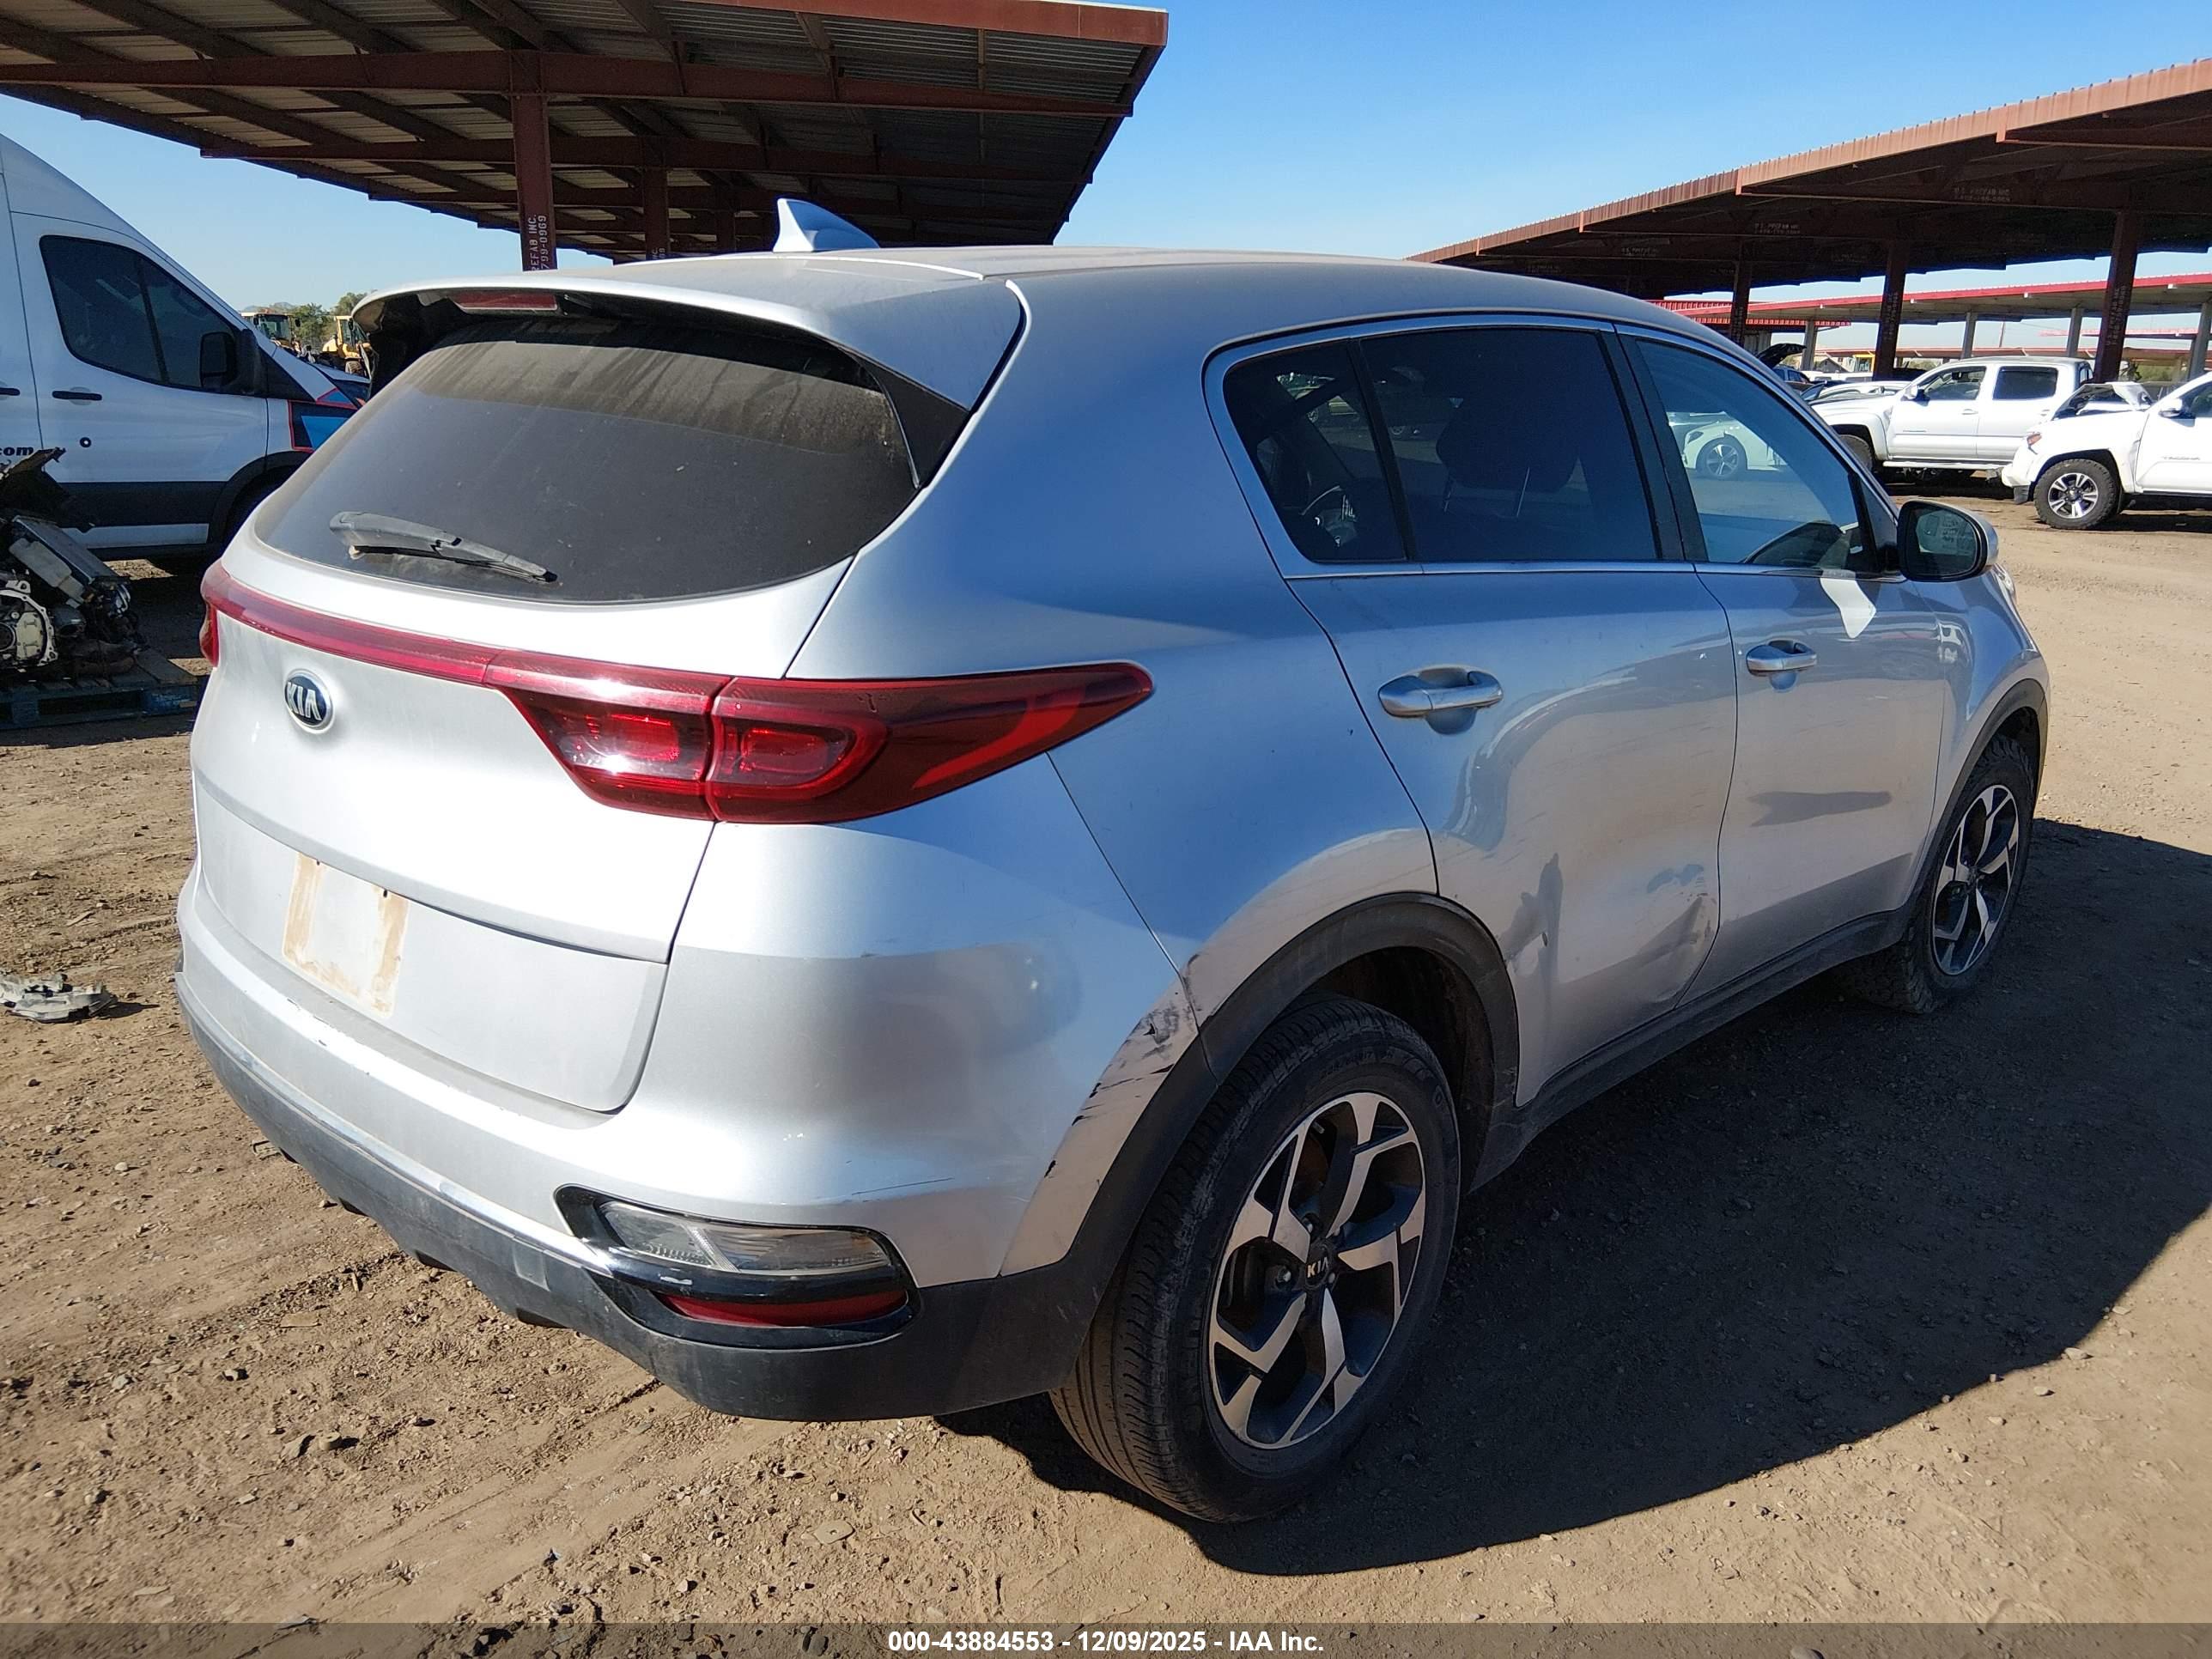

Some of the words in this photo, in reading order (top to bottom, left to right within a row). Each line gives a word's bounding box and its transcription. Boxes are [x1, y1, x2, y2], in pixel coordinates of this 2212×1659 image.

[528, 214, 538, 234] INC.
[0, 447, 34, 456] om
[287, 681, 322, 720] KIA
[1307, 1256, 1329, 1279] KIA
